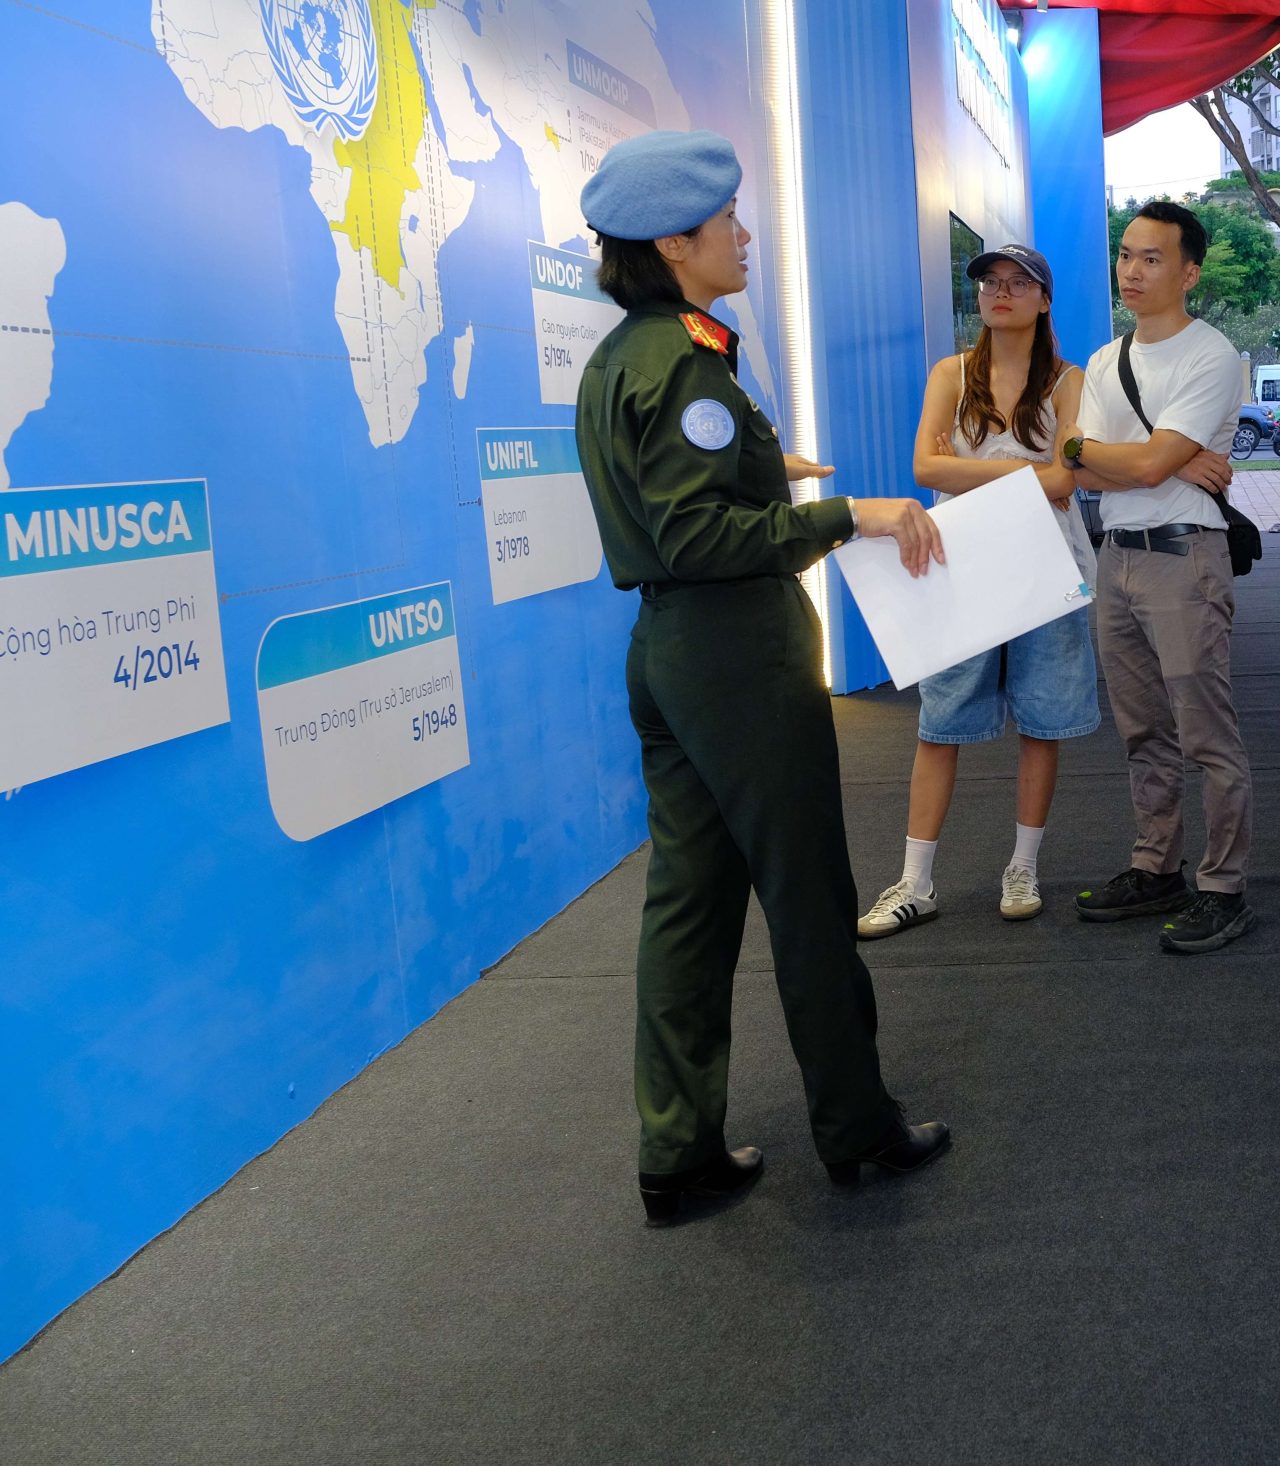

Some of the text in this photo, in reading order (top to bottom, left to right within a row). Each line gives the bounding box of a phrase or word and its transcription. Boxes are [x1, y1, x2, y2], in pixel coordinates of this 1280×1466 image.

[573, 53, 629, 105] UNMOGIP
[577, 106, 601, 130] Jammu
[536, 254, 583, 290] UNDOF
[541, 318, 556, 334] Cao
[580, 325, 598, 340] Golan
[544, 344, 573, 368] 5/1974
[485, 440, 539, 471] UNIFIL
[4, 500, 193, 561] MINUSCA
[493, 509, 528, 526] Lebanon
[495, 536, 530, 564] 3/1978
[57, 615, 98, 645] hòa
[101, 607, 161, 636] Trung
[166, 595, 196, 624] Phi
[369, 598, 444, 648] UNTSO
[113, 640, 200, 690] 4/2014
[274, 670, 455, 747] Trung Đông (Trụ sở Jerusalem)
[412, 703, 458, 742] 5/1948
